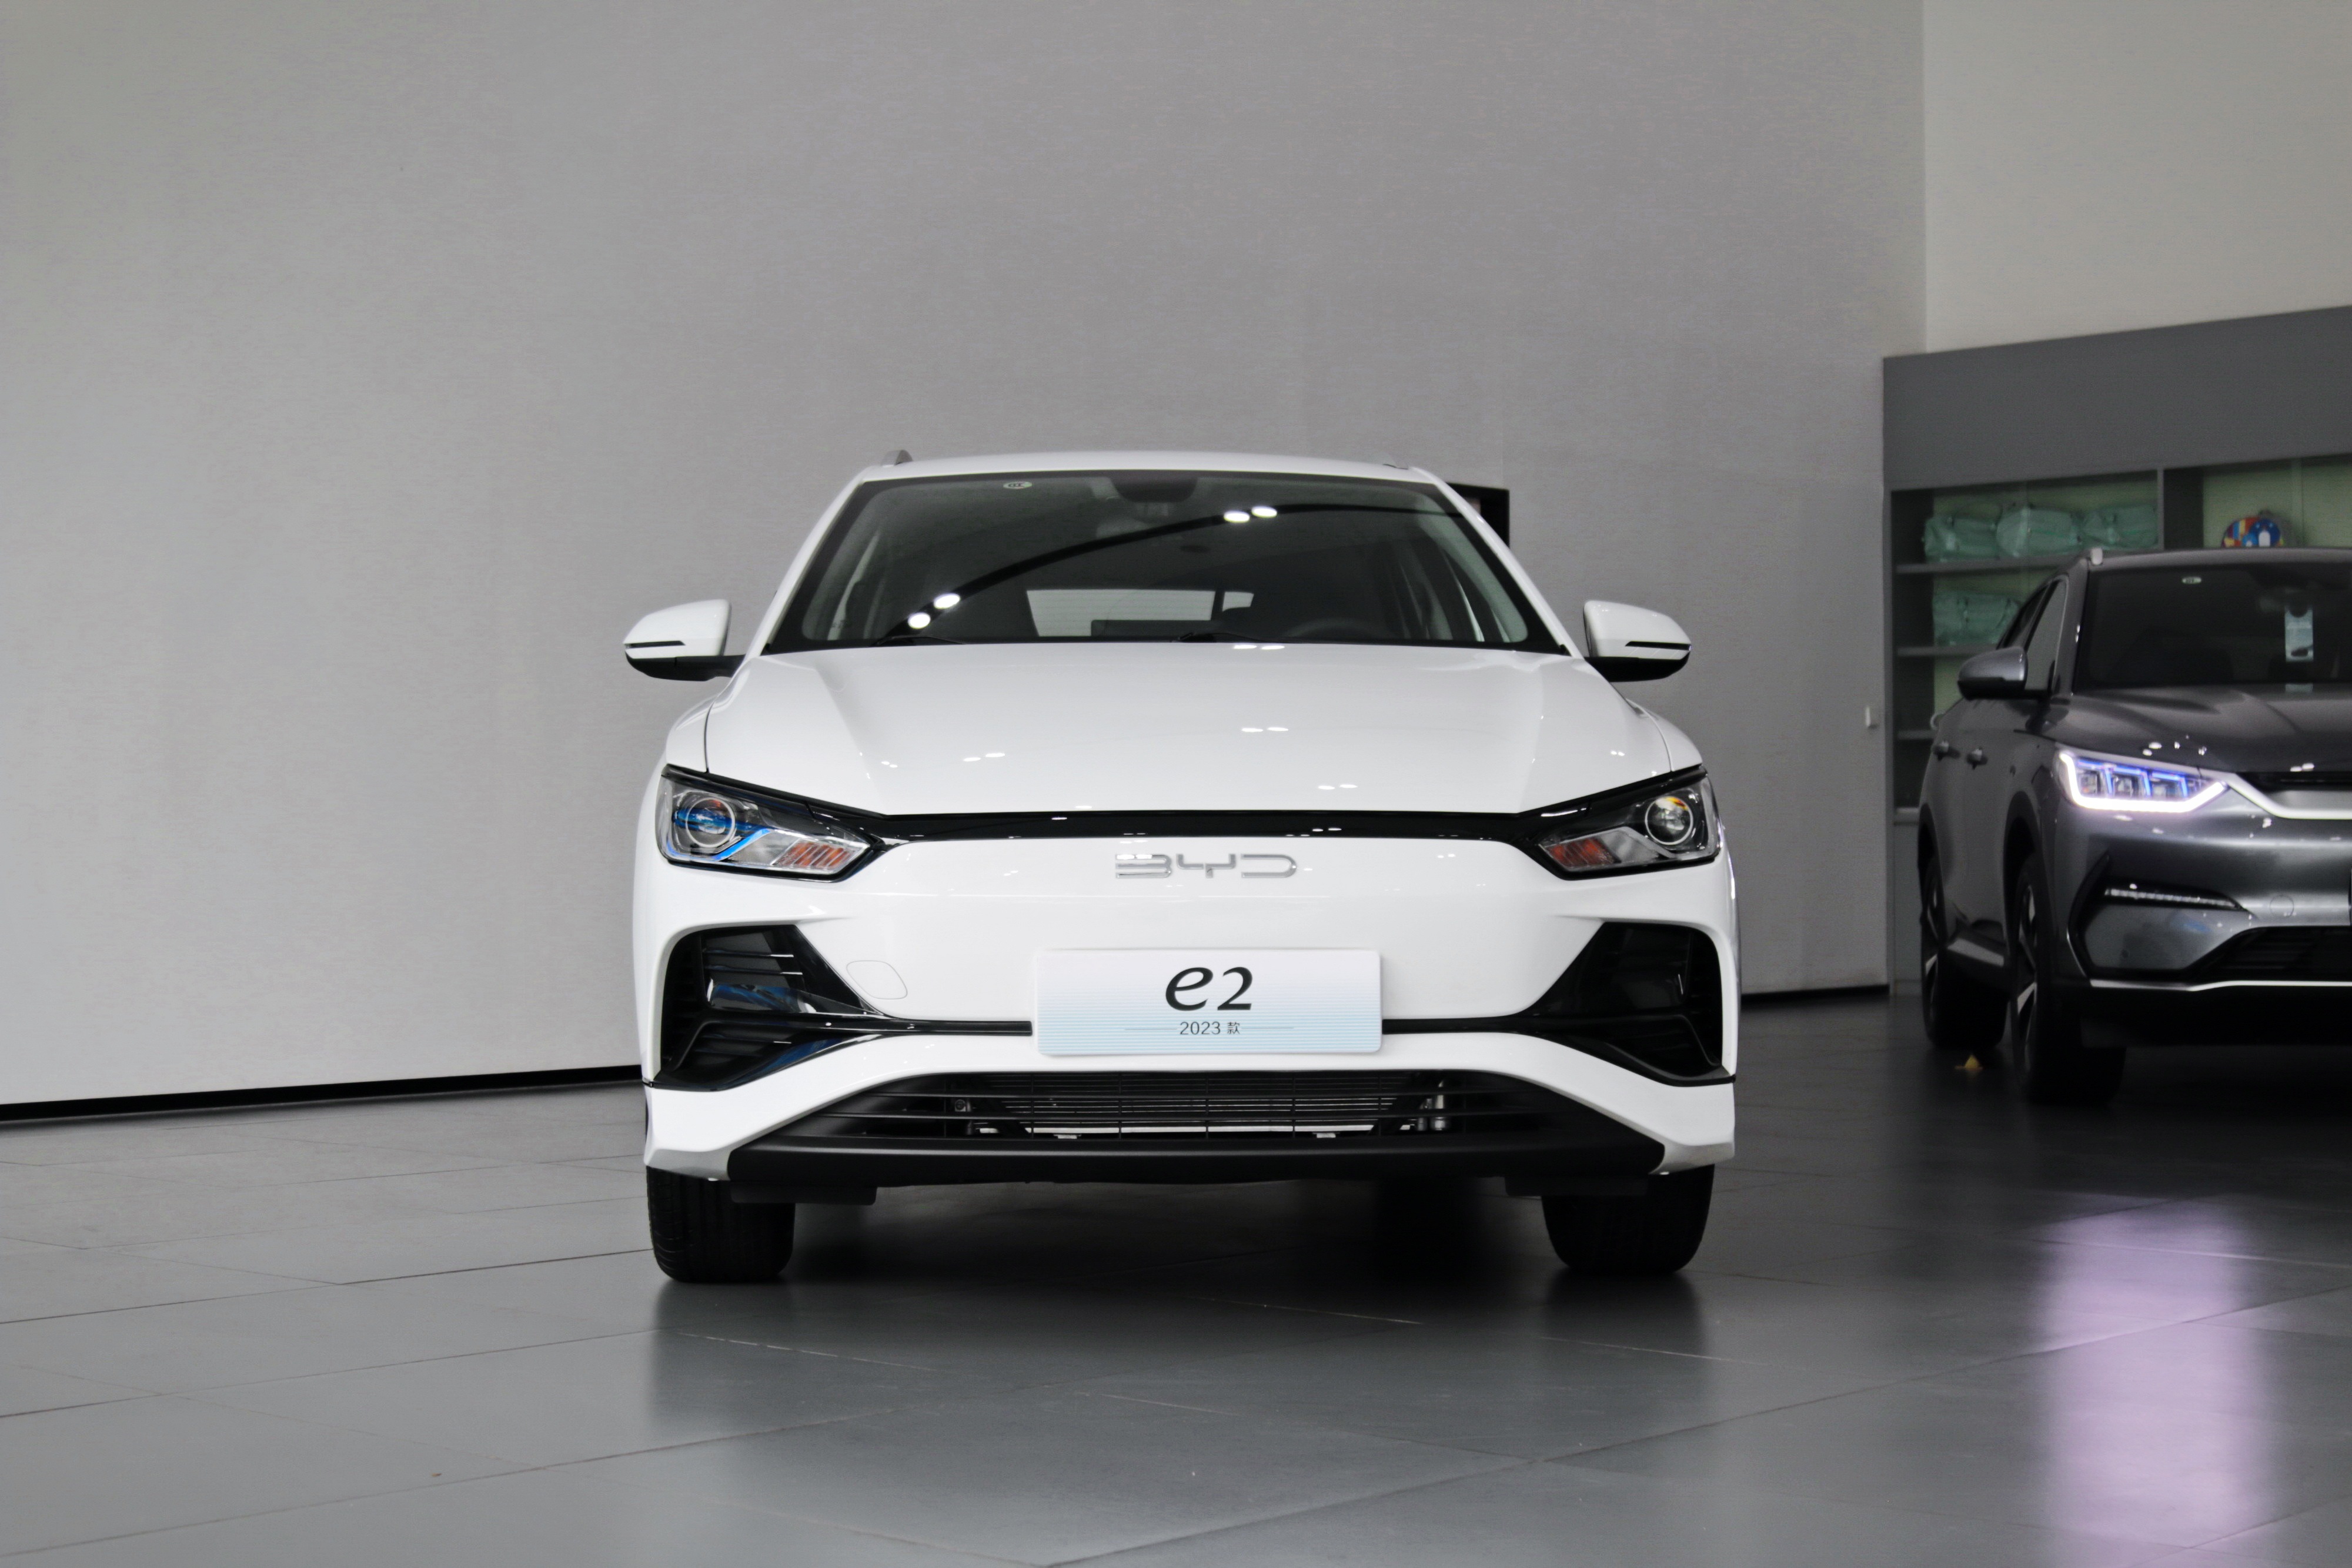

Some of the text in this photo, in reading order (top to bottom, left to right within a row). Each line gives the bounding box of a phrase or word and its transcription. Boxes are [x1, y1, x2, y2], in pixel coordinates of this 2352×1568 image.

[1115, 853, 1297, 878] BYD
[1165, 966, 1253, 1012] e2
[1180, 1021, 1241, 1035] 2023 款
